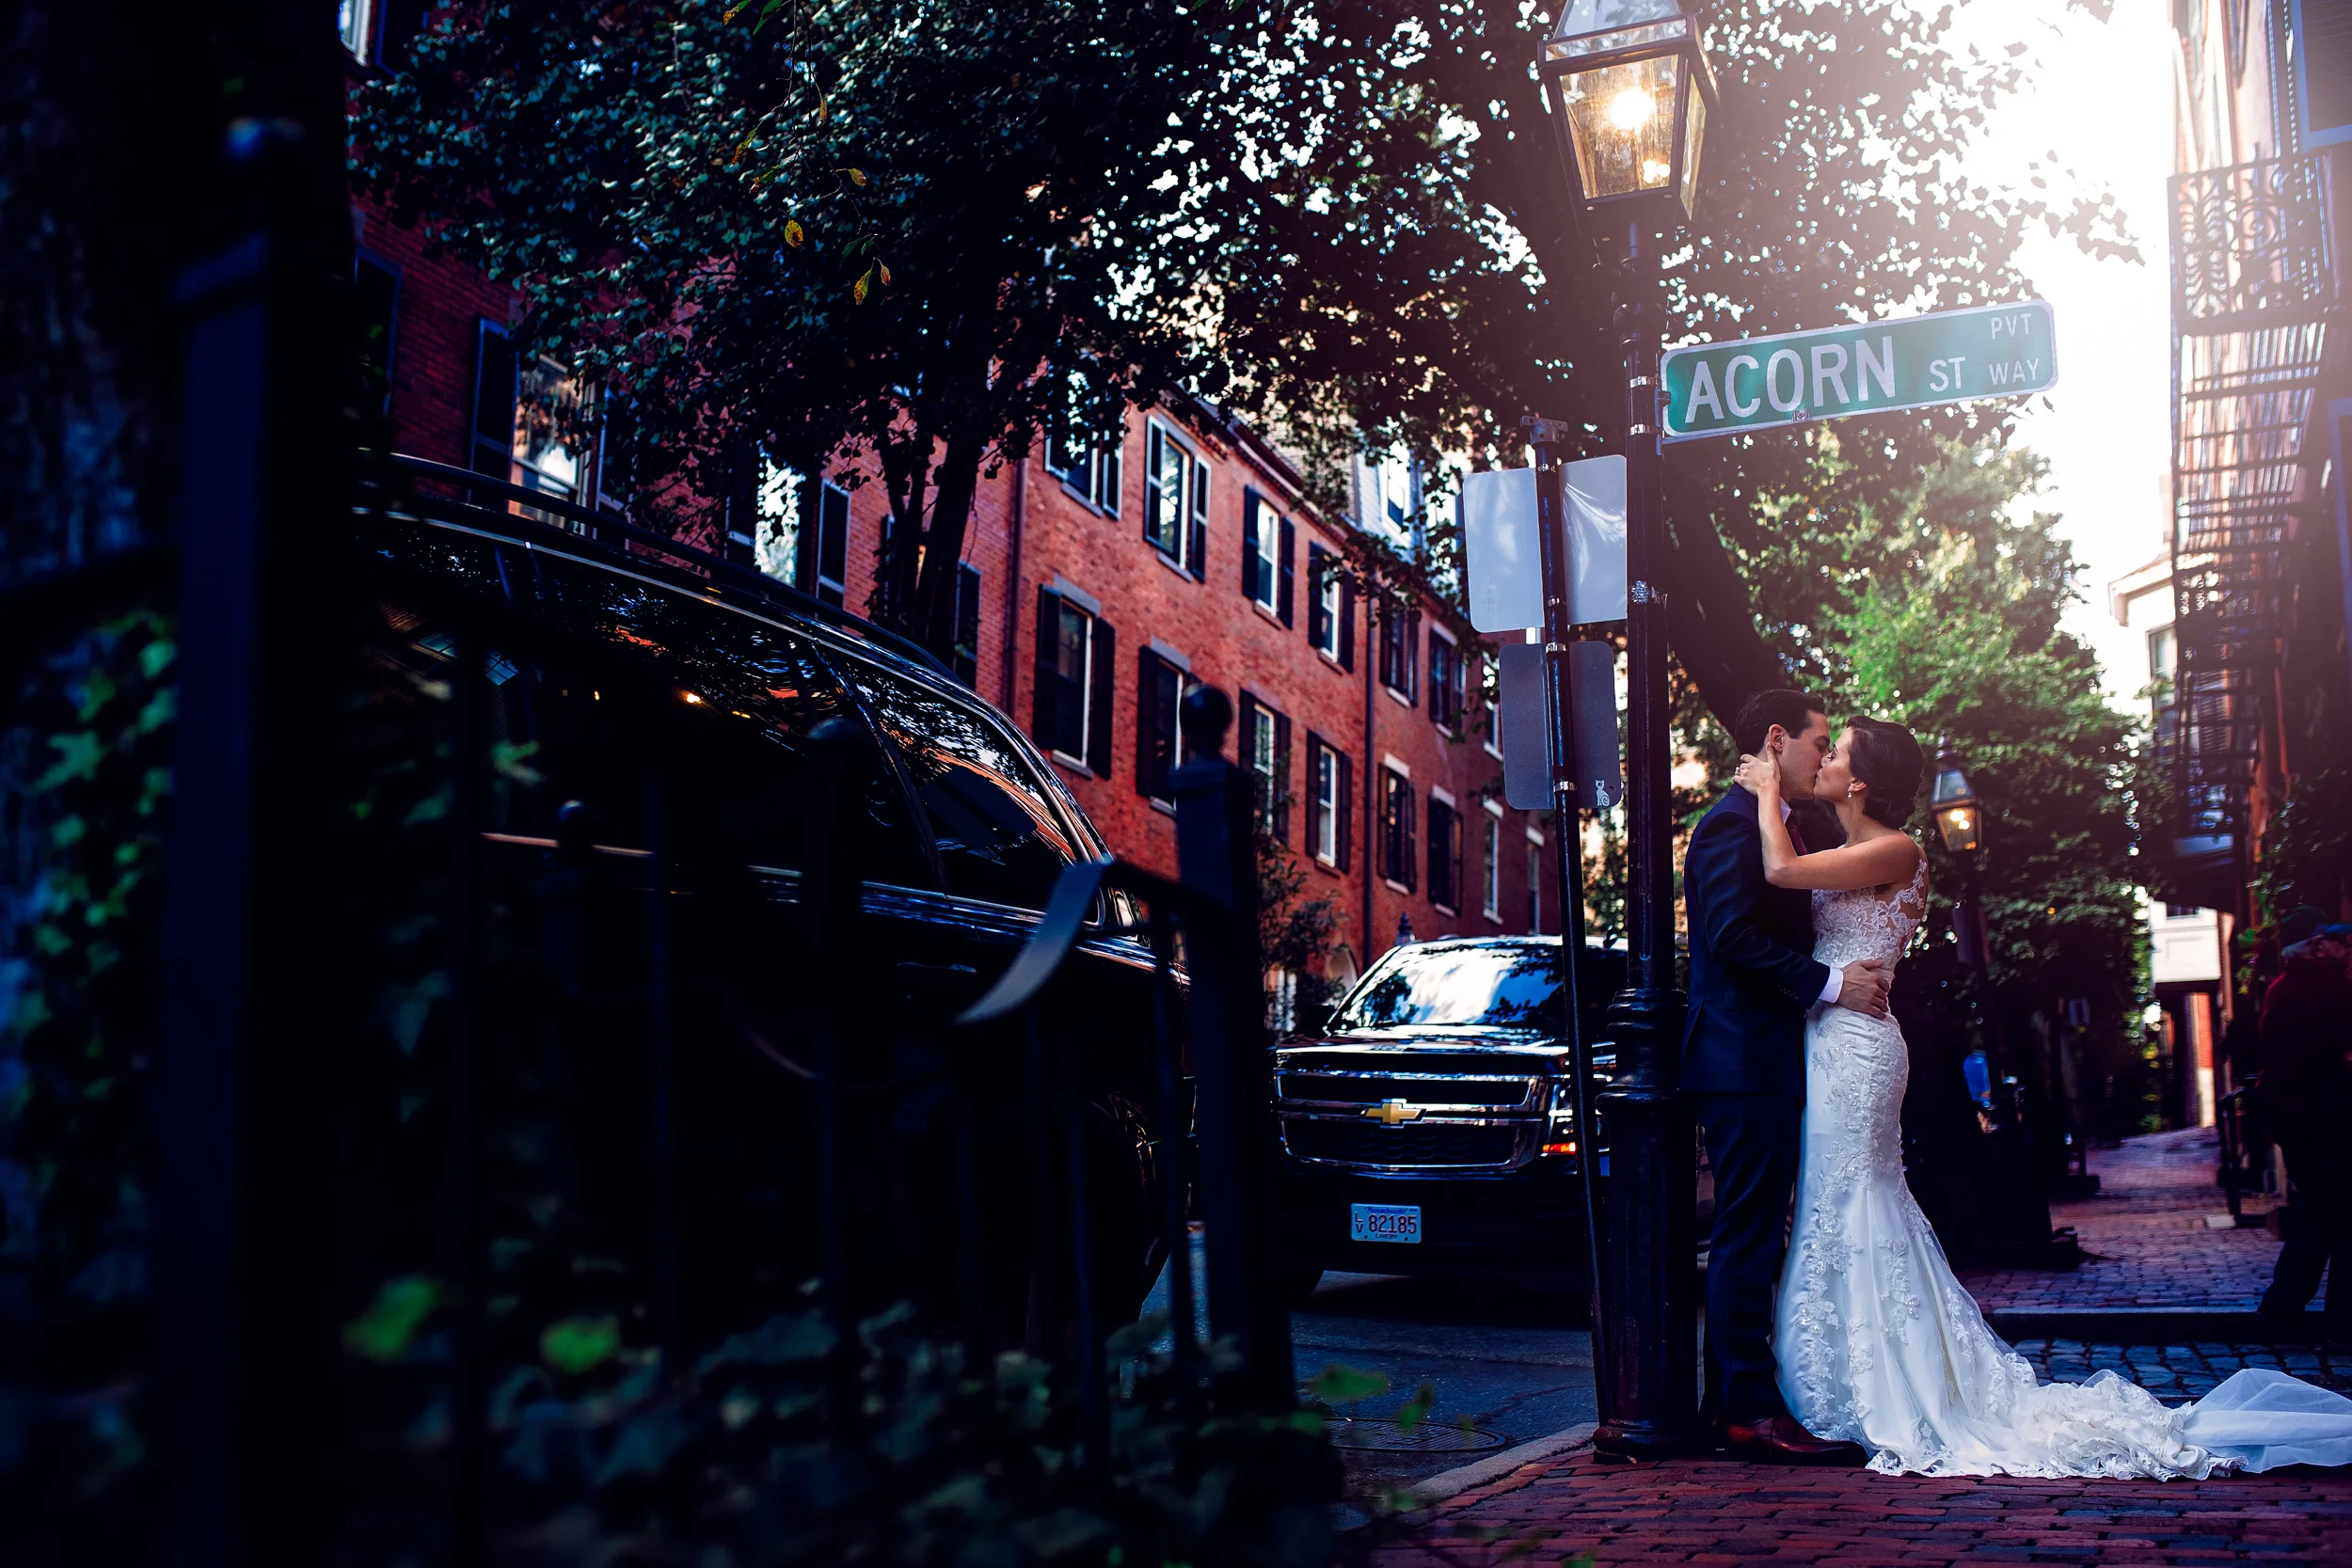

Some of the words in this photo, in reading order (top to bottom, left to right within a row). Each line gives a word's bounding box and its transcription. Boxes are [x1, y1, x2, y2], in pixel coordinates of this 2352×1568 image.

[1991, 313, 2032, 340] PVT
[1685, 336, 1896, 423] ACORN
[1930, 356, 1966, 392] ST
[1989, 358, 2040, 387] WAY
[1369, 1214, 1417, 1234] 82185
